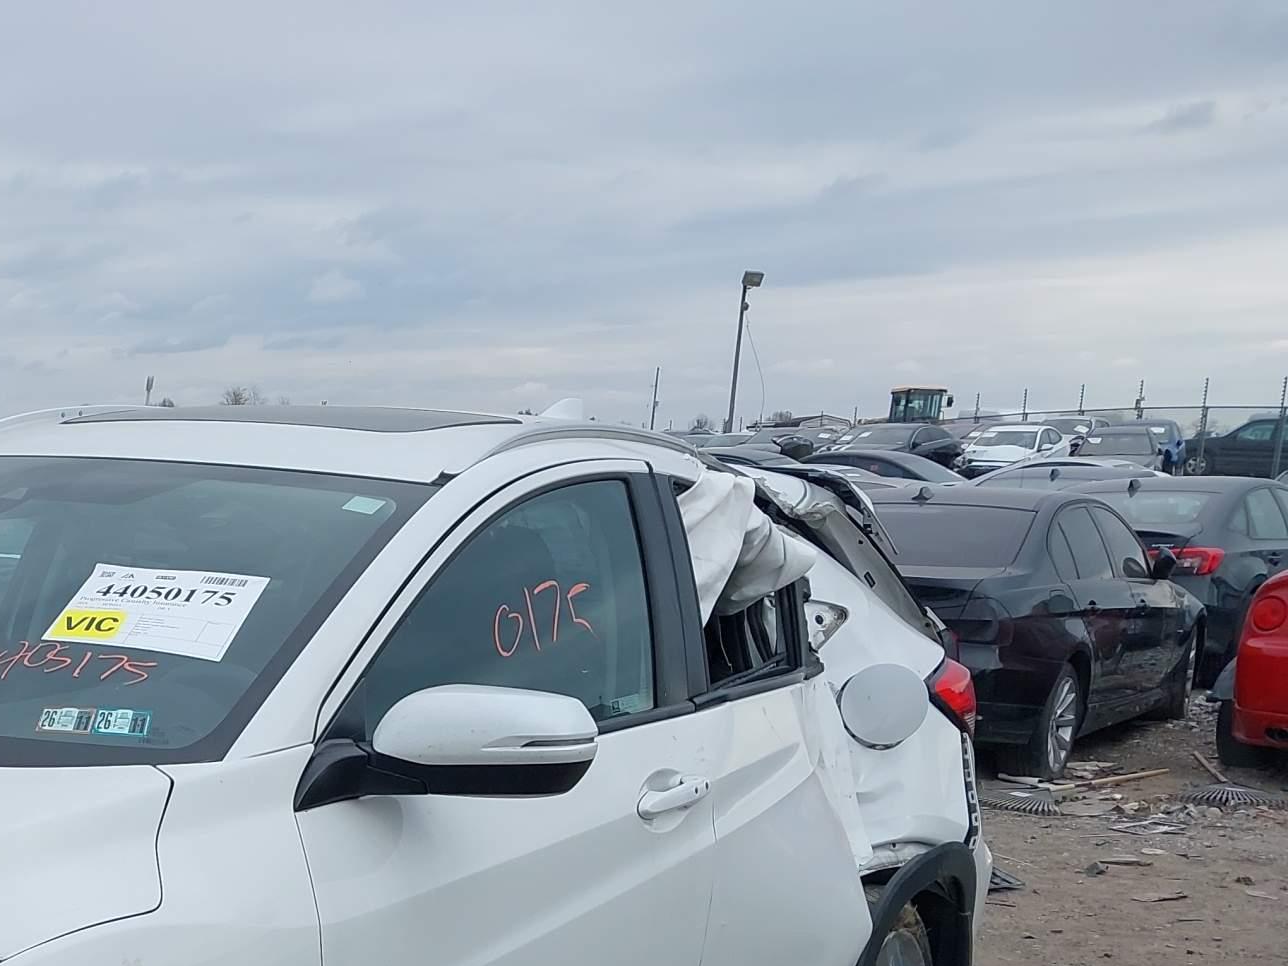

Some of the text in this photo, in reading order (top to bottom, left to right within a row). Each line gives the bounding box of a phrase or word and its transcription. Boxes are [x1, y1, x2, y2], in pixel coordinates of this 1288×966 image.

[96, 583, 237, 607] 44050175
[65, 616, 119, 632] VIC
[494, 579, 598, 657] 0175
[41, 710, 58, 728] 26
[97, 711, 113, 729] 26
